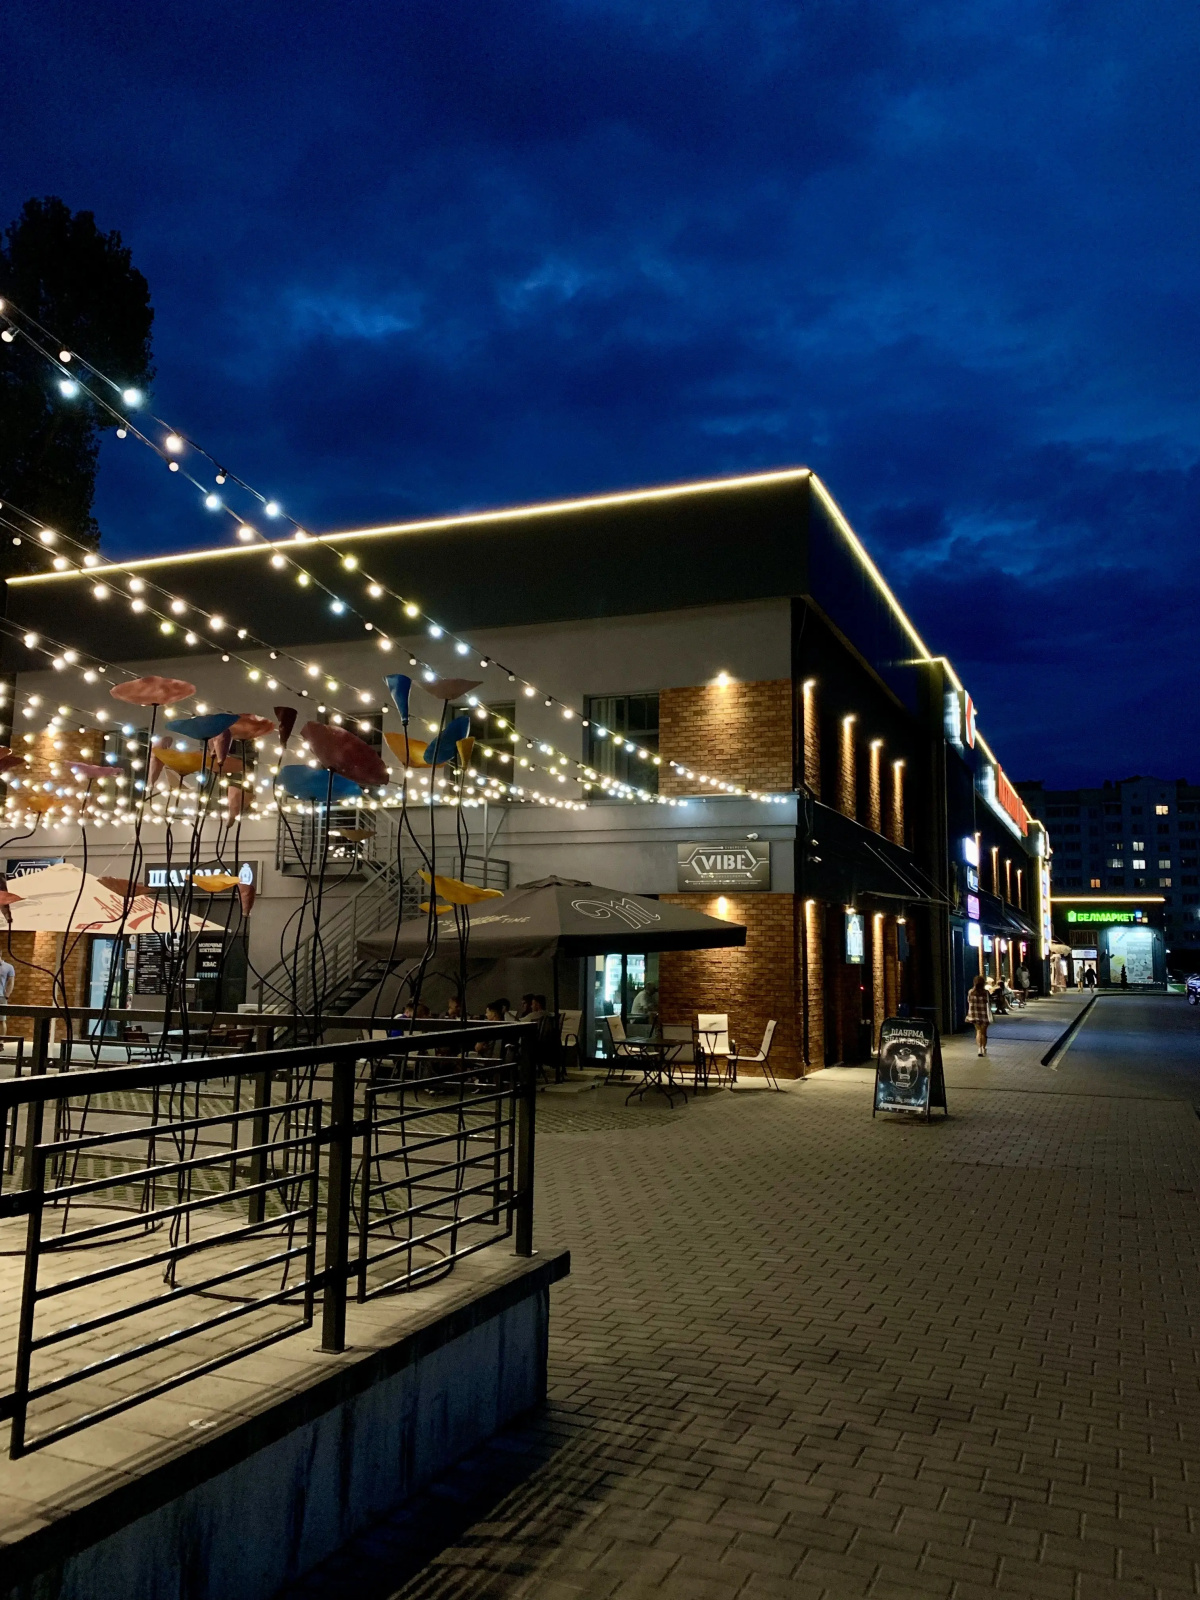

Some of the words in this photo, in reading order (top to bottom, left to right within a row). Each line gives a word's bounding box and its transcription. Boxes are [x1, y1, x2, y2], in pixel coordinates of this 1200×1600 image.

[701, 854, 746, 870] VIBE
[1077, 912, 1135, 922] БЕЛМАРКЕТ
[891, 1028, 924, 1038] ШАУРМА
